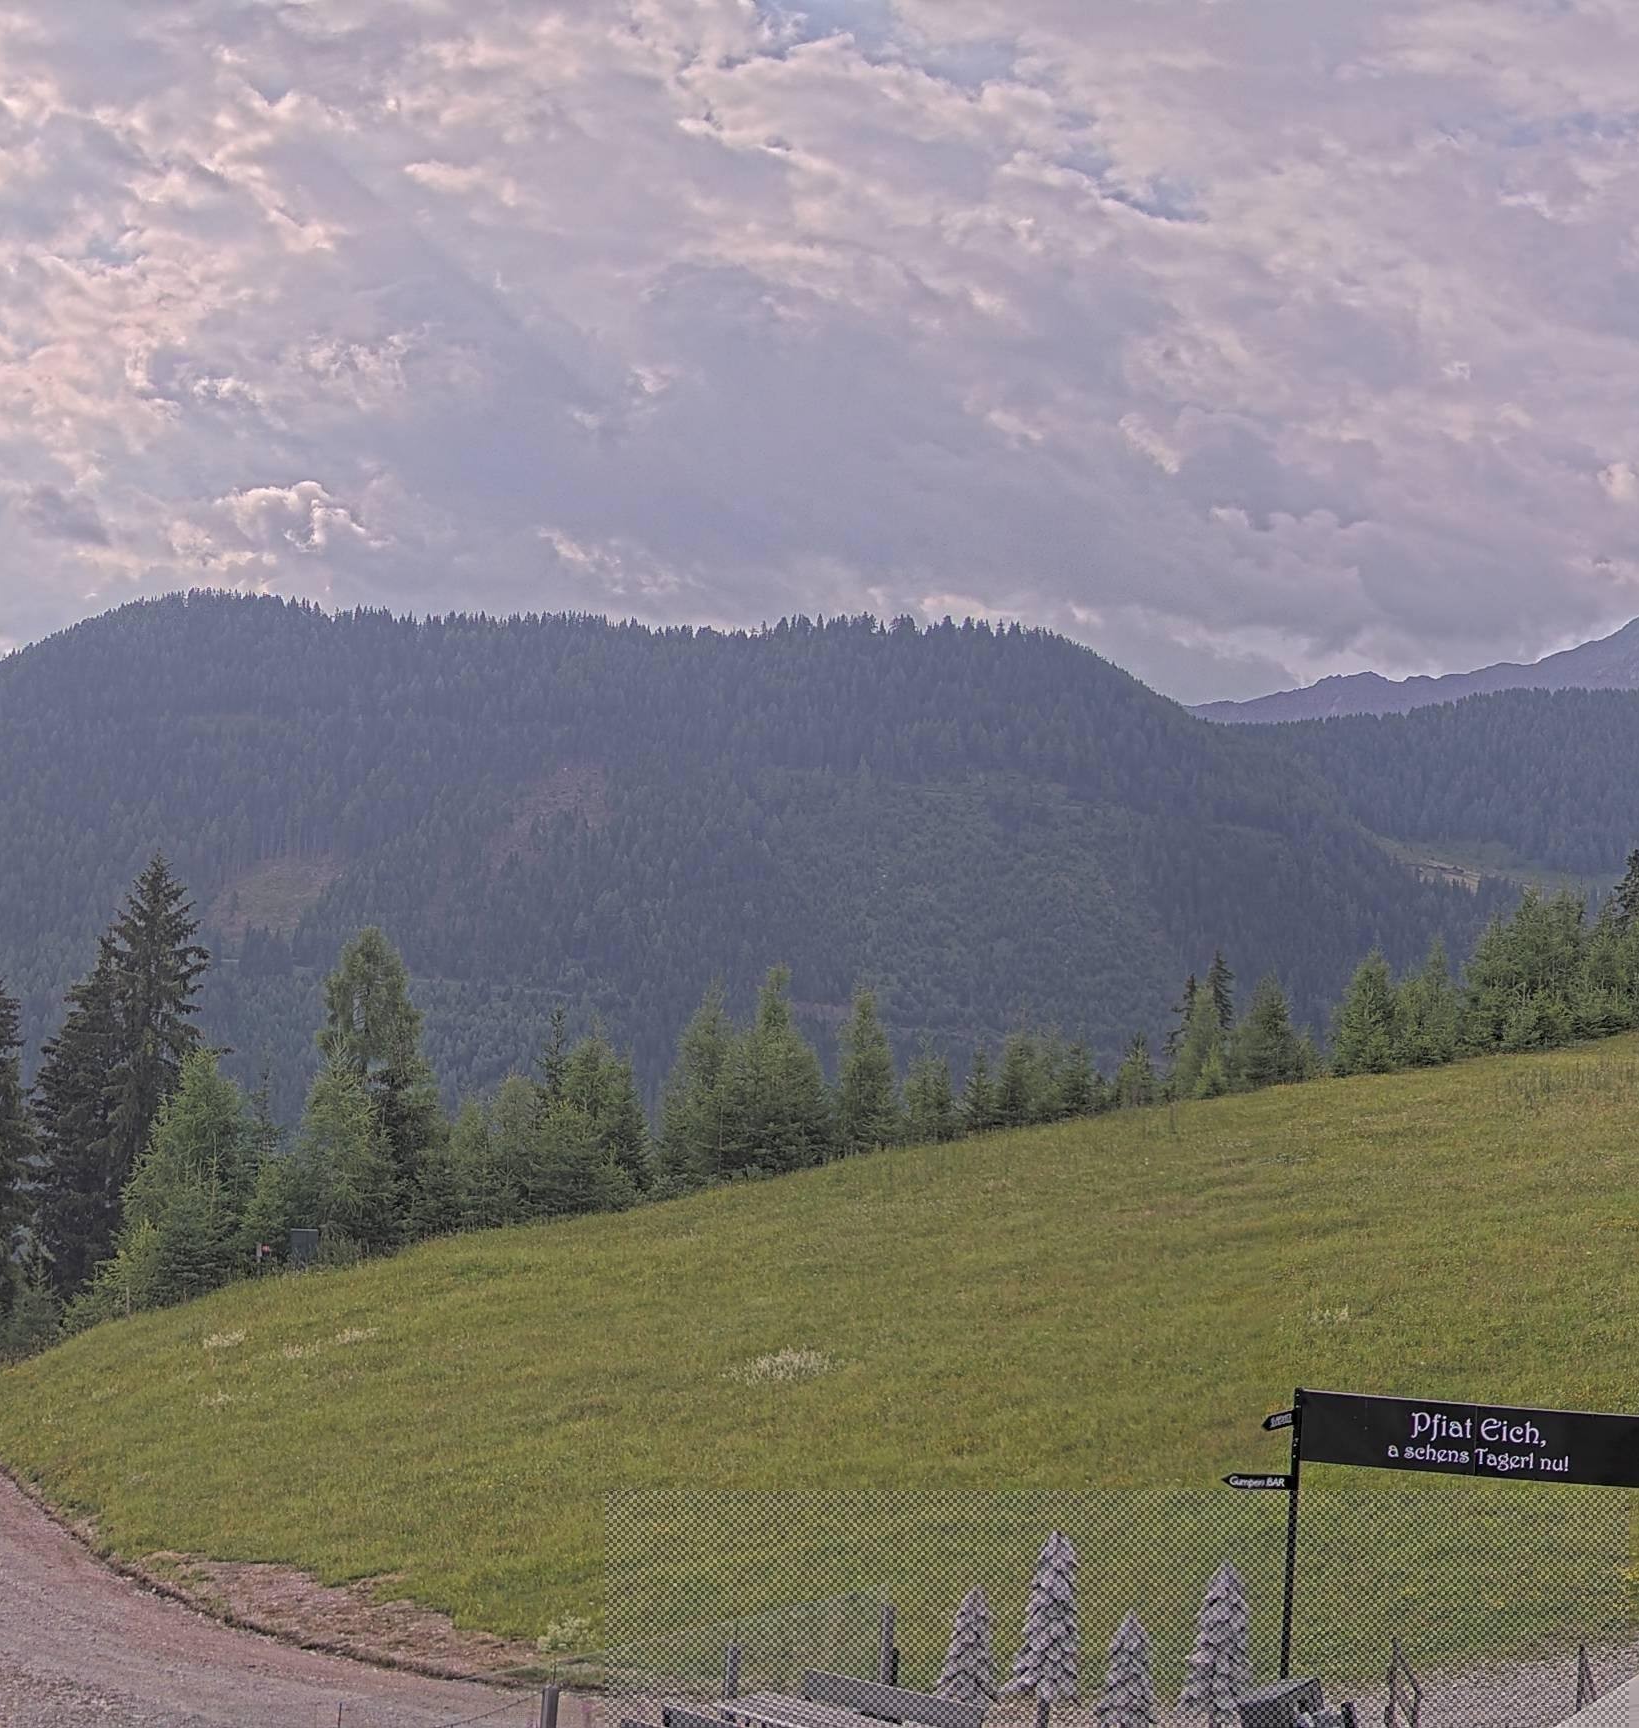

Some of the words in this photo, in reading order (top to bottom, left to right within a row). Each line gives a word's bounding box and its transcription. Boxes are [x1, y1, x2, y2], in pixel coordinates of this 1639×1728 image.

[1411, 1411, 1472, 1441] Pfiat
[1480, 1418, 1547, 1448] Eich,
[1388, 1445, 1399, 1458] a
[1404, 1444, 1470, 1464] schens
[1474, 1448, 1534, 1472] Tagerl
[1540, 1456, 1570, 1472] nu!
[1266, 1477, 1285, 1487] BAR
